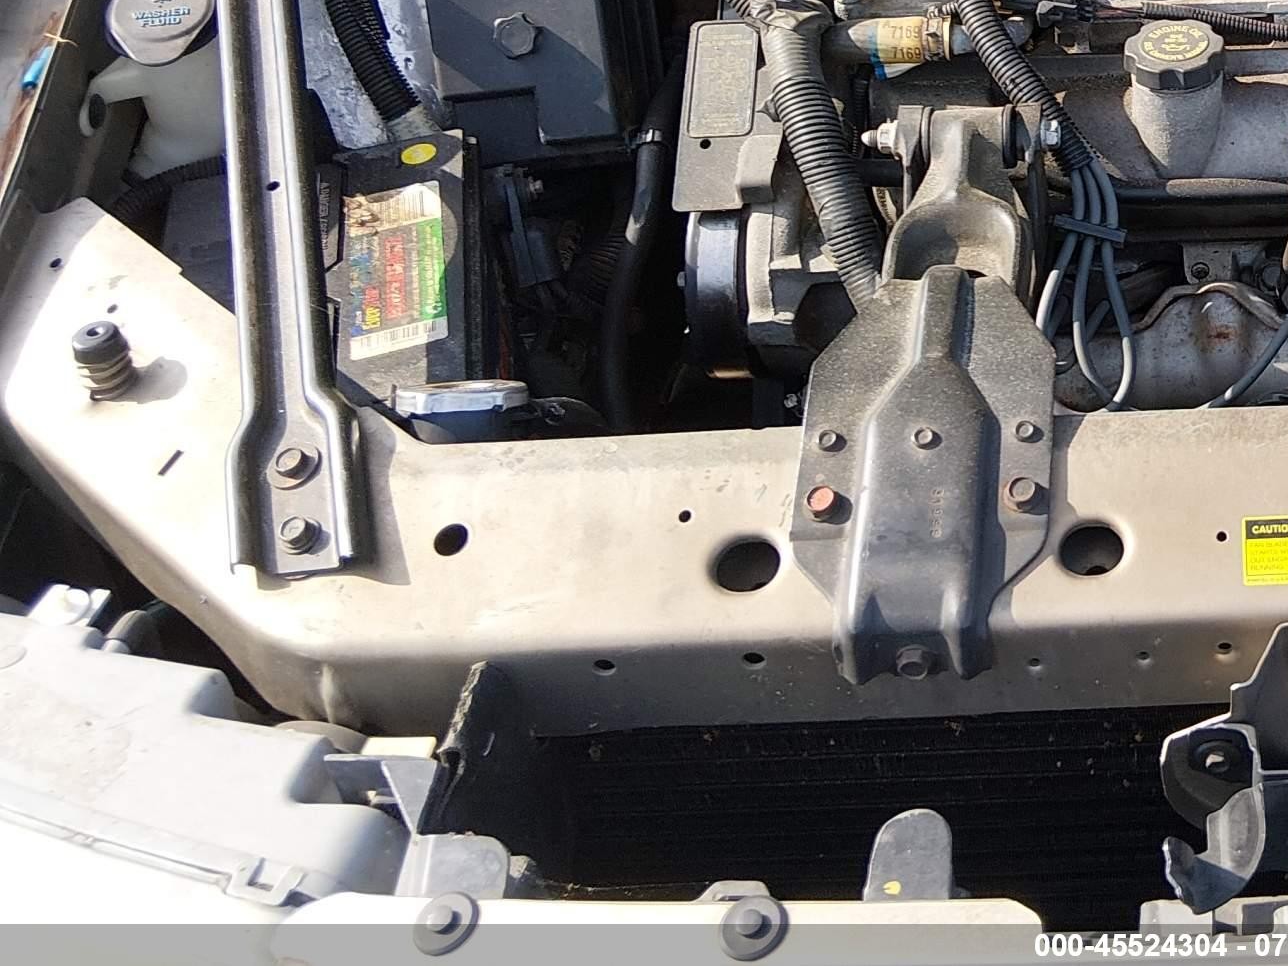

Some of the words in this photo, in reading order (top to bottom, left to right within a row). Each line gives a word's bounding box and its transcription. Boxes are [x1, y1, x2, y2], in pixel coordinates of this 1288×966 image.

[132, 7, 191, 20] WASHER
[142, 17, 182, 27] FLUID
[890, 26, 921, 38] 7169
[1148, 25, 1188, 39] ENGINE
[891, 47, 921, 59] 7169
